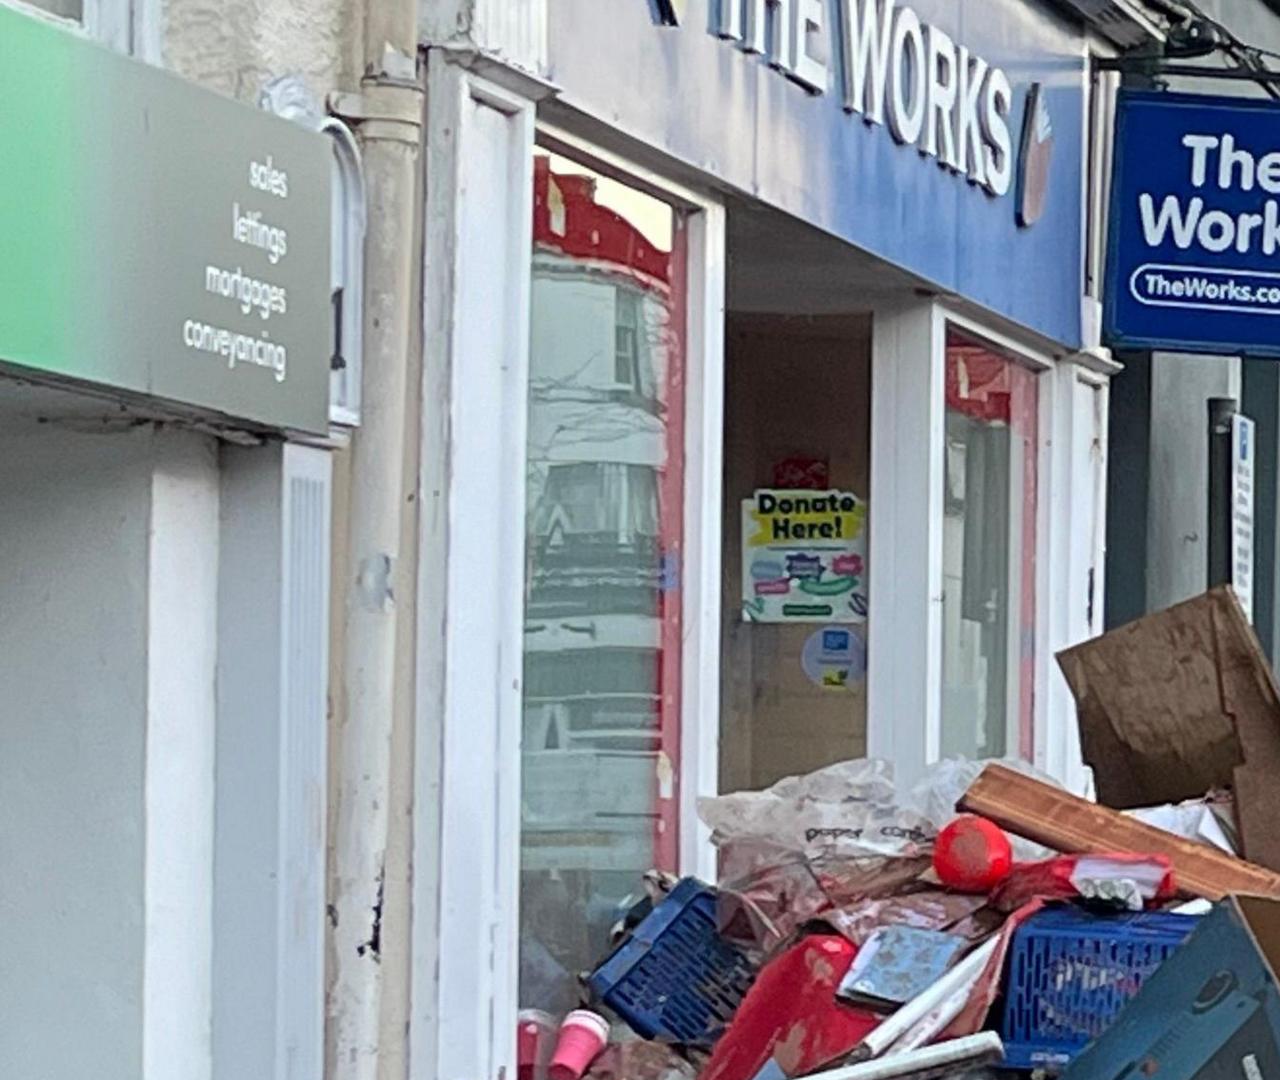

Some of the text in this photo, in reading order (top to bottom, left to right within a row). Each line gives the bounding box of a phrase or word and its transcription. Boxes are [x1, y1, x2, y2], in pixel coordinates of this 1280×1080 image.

[846, 0, 1013, 198] WORKS
[249, 154, 287, 198] sales
[233, 201, 287, 264] lettings
[206, 265, 287, 319] mortgages
[184, 319, 287, 382] conveyancing
[758, 494, 855, 514] Donate
[772, 518, 843, 540] Here!
